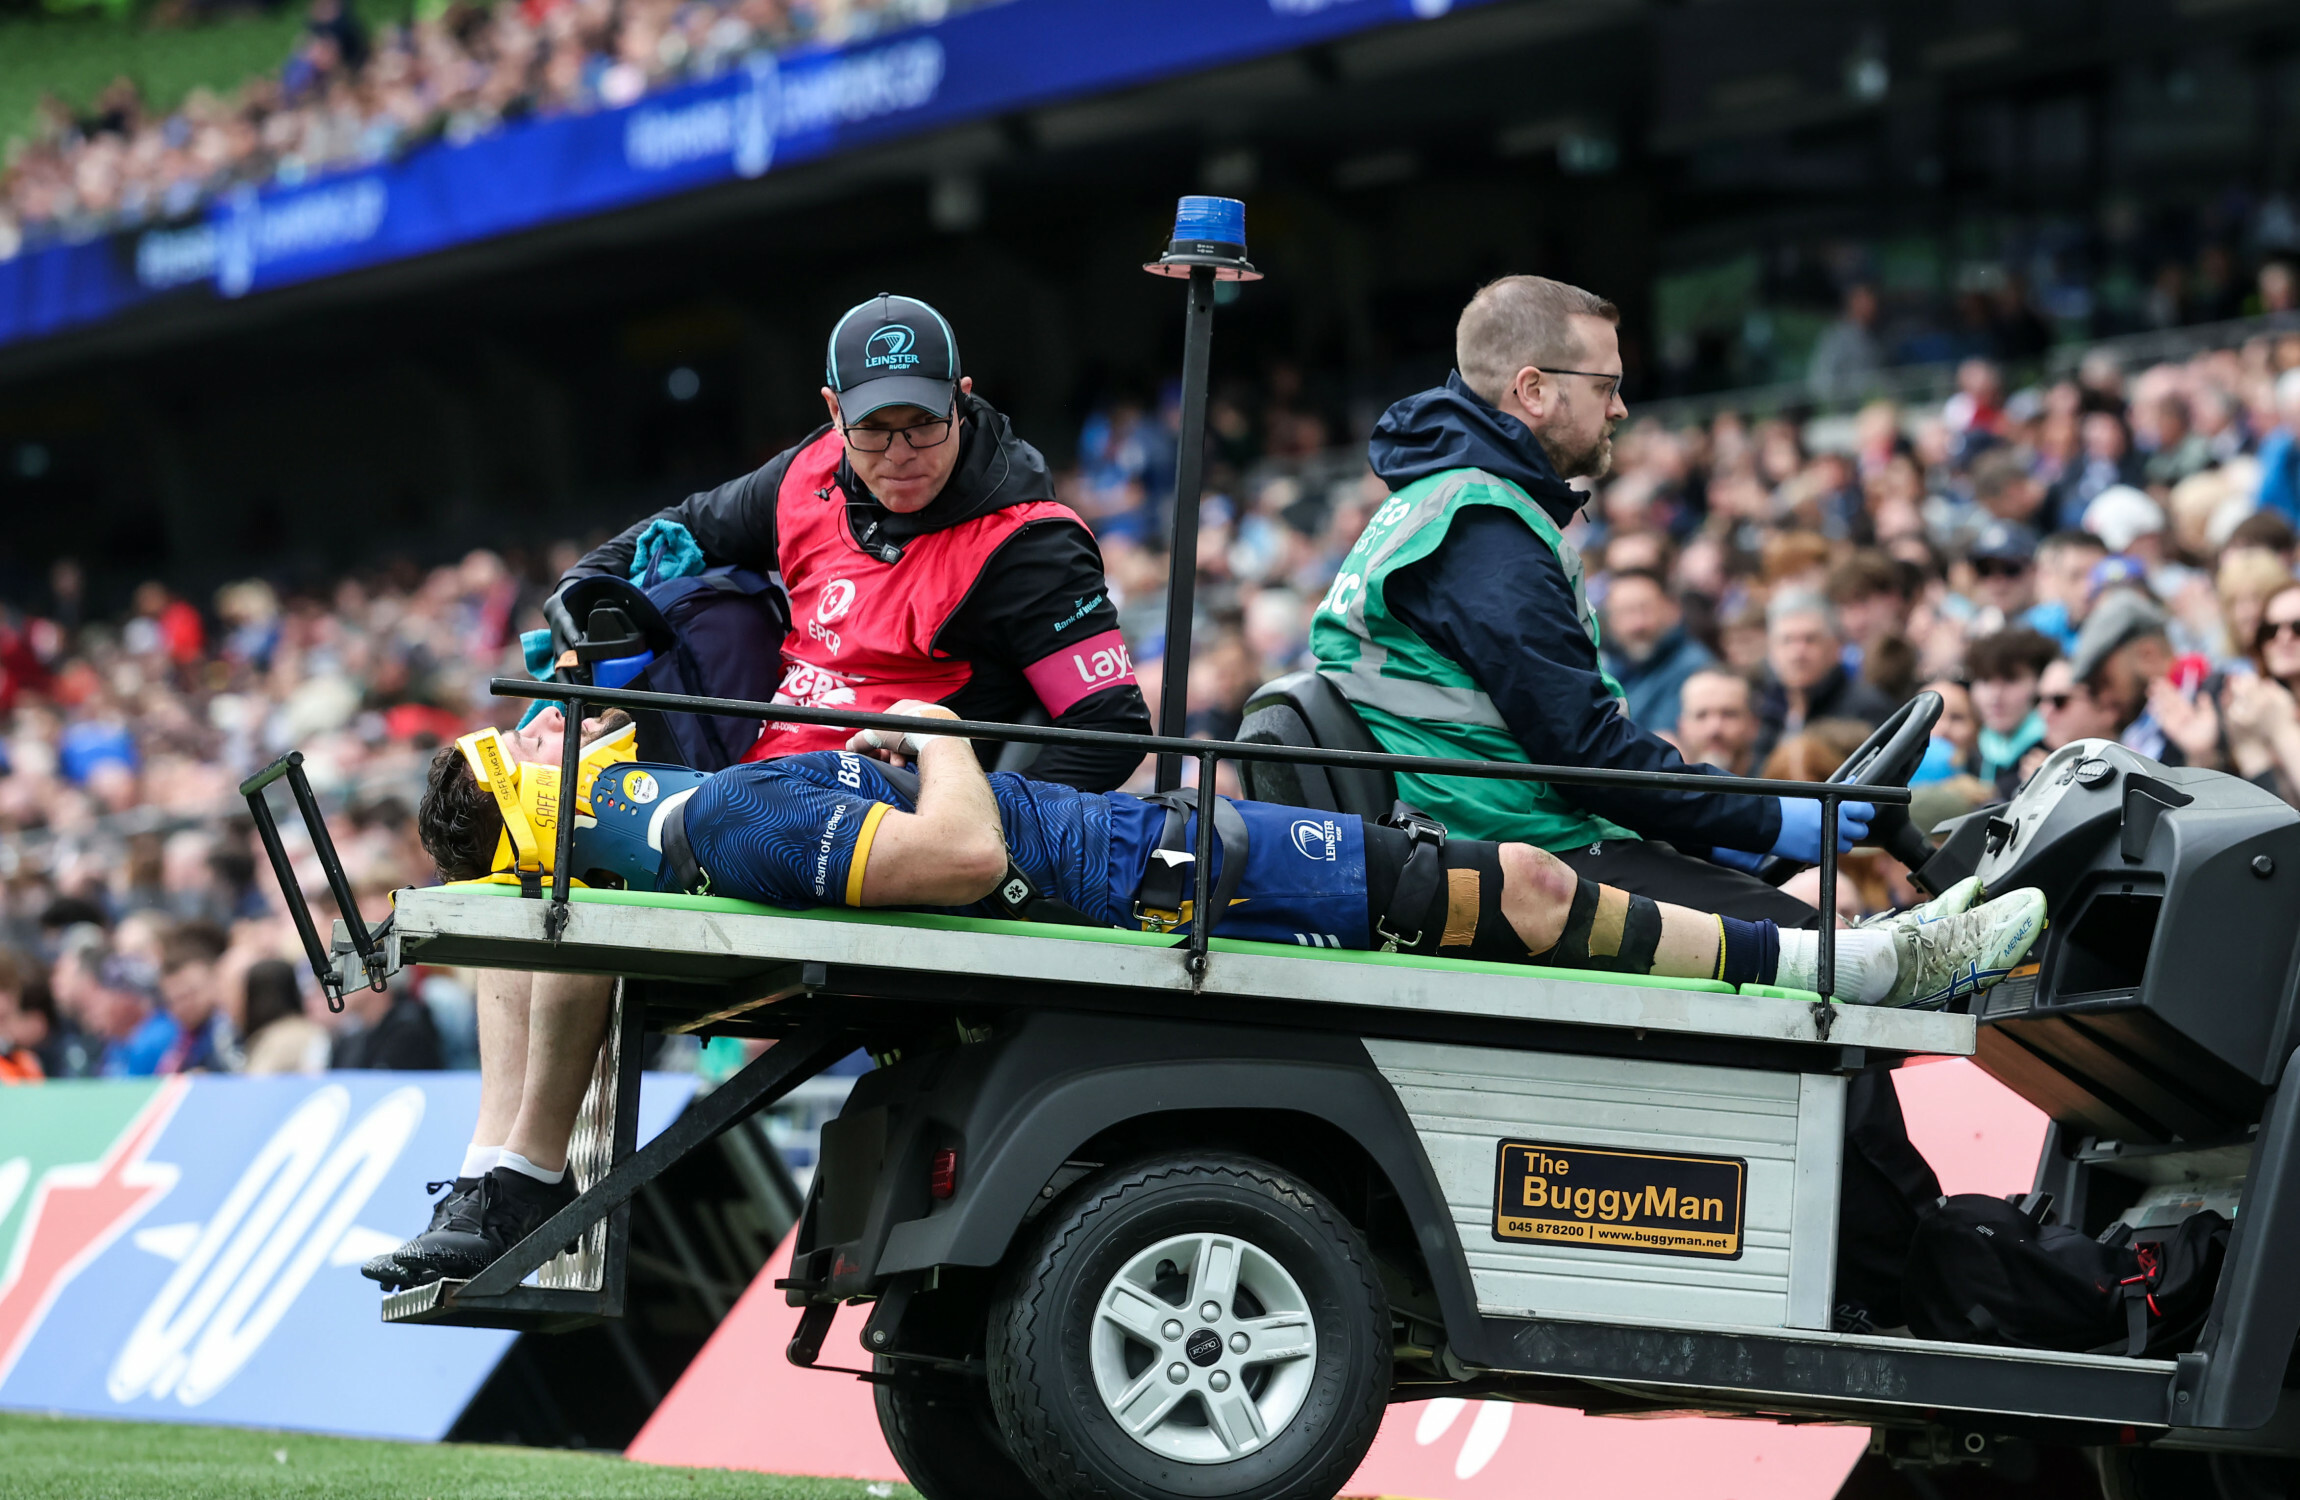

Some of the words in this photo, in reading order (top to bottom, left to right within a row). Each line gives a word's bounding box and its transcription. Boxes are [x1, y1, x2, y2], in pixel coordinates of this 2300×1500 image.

[865, 354, 919, 368] LEINSTER
[1053, 615, 1076, 632] Bank
[1076, 608, 1084, 620] of
[1082, 594, 1103, 614] Ireland
[808, 619, 841, 656] EPCR
[486, 745, 503, 776] RUGBY
[496, 777, 512, 801] SAFE
[534, 790, 558, 830] SAFE
[822, 804, 847, 839] Ireland
[820, 838, 832, 853] of
[1323, 820, 1336, 861] LEINSTER
[815, 853, 829, 885] Bank
[2004, 916, 2033, 957] MENACE
[1523, 1151, 1570, 1176] The
[1522, 1175, 1724, 1222] BuggyMan
[1508, 1221, 1533, 1233] 045
[1536, 1223, 1584, 1237] 878200
[1598, 1229, 1728, 1249] www.buggyman.net
